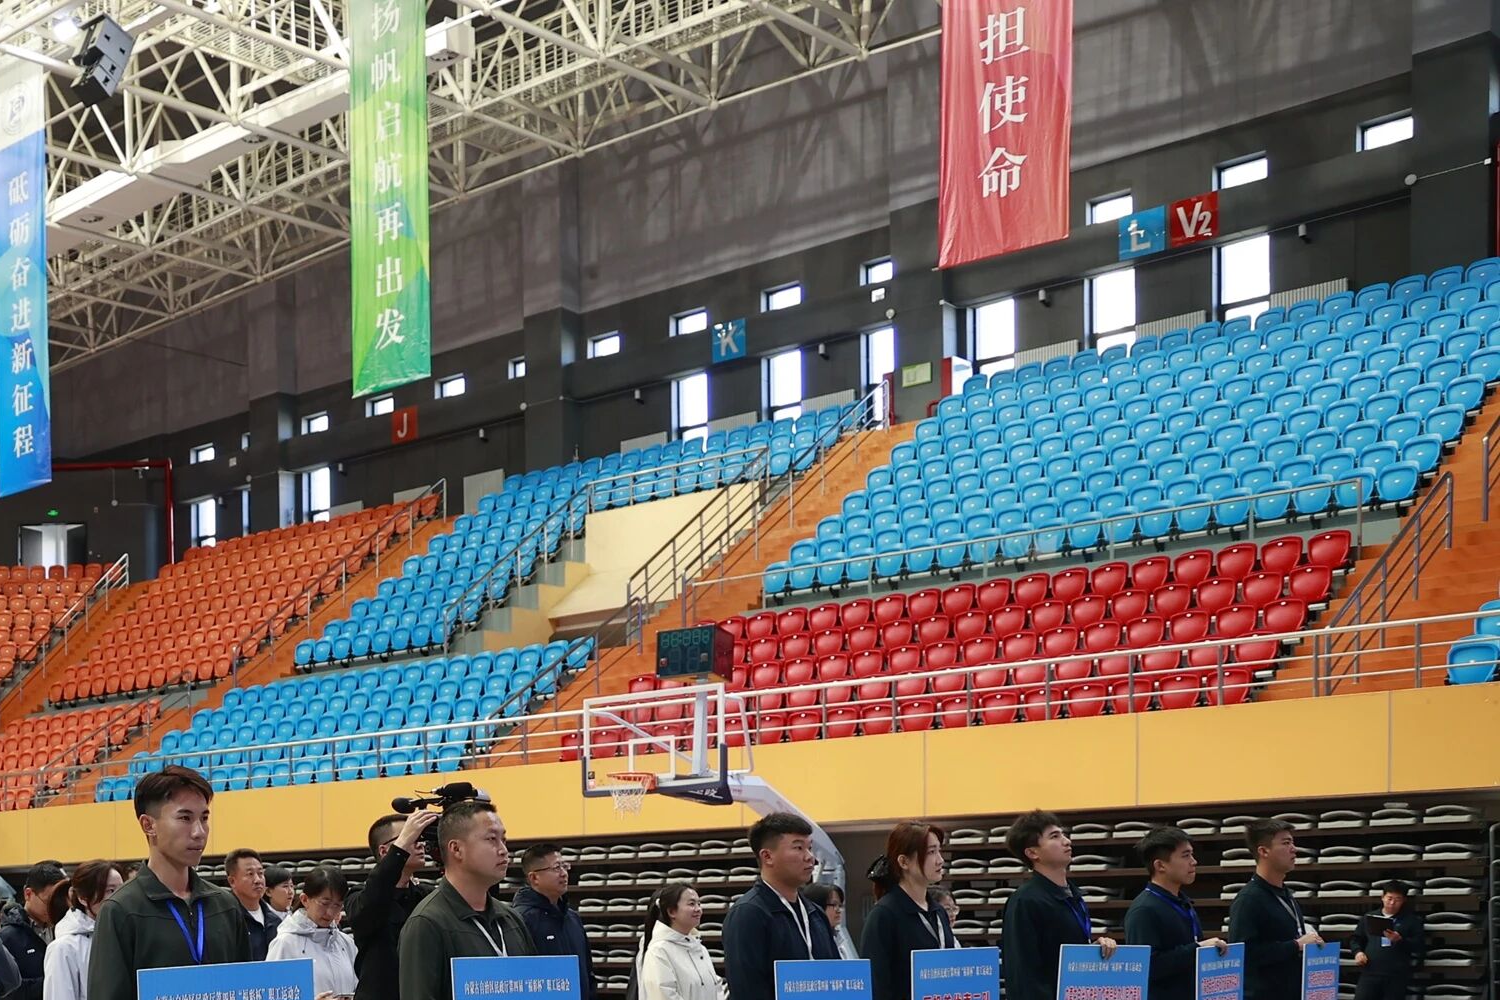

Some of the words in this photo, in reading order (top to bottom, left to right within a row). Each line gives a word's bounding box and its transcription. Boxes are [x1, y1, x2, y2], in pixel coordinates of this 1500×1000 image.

[370, 0, 405, 350] 扬帆启航再出发
[978, 6, 1030, 198] 担使命
[8, 170, 35, 459] 砥砺奋进新征程
[1176, 201, 1212, 238] V2
[397, 412, 408, 438] J
